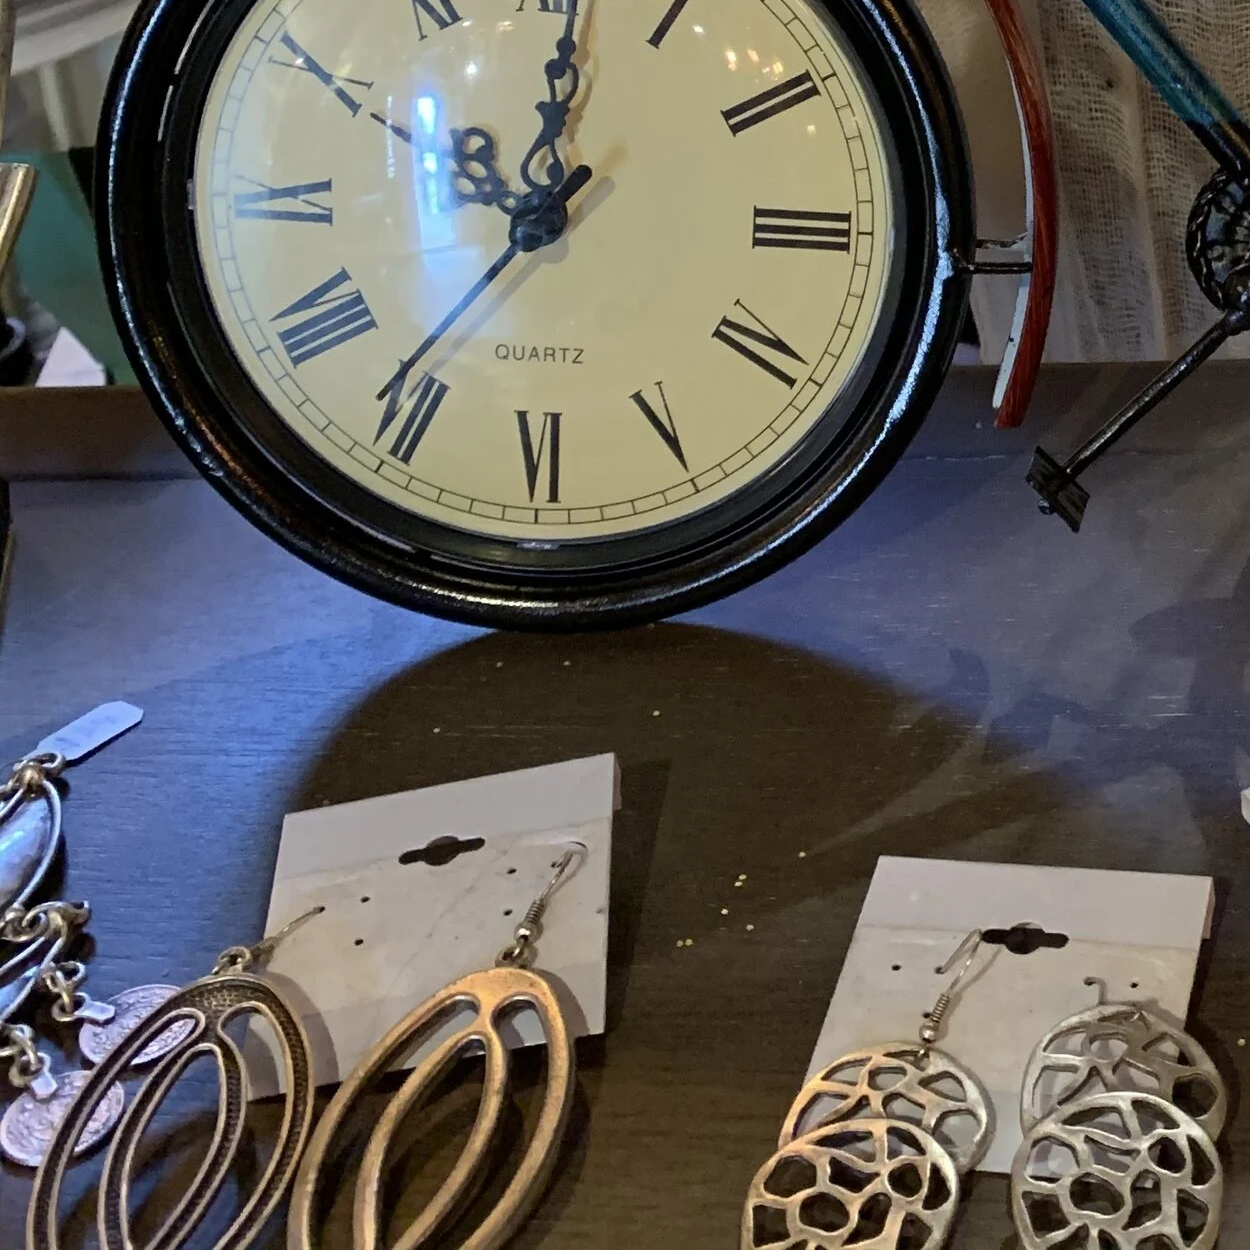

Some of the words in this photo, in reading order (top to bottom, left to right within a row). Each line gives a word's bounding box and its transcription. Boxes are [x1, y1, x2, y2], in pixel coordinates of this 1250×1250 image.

[267, 30, 375, 118] X
[719, 69, 822, 137] II
[233, 174, 334, 226] IX
[752, 205, 852, 255] III
[269, 266, 379, 369] VIII
[495, 343, 584, 364] QUARTZ
[711, 299, 810, 390] IV
[372, 359, 451, 466] VII
[513, 409, 563, 504] VI
[628, 381, 689, 474] V
